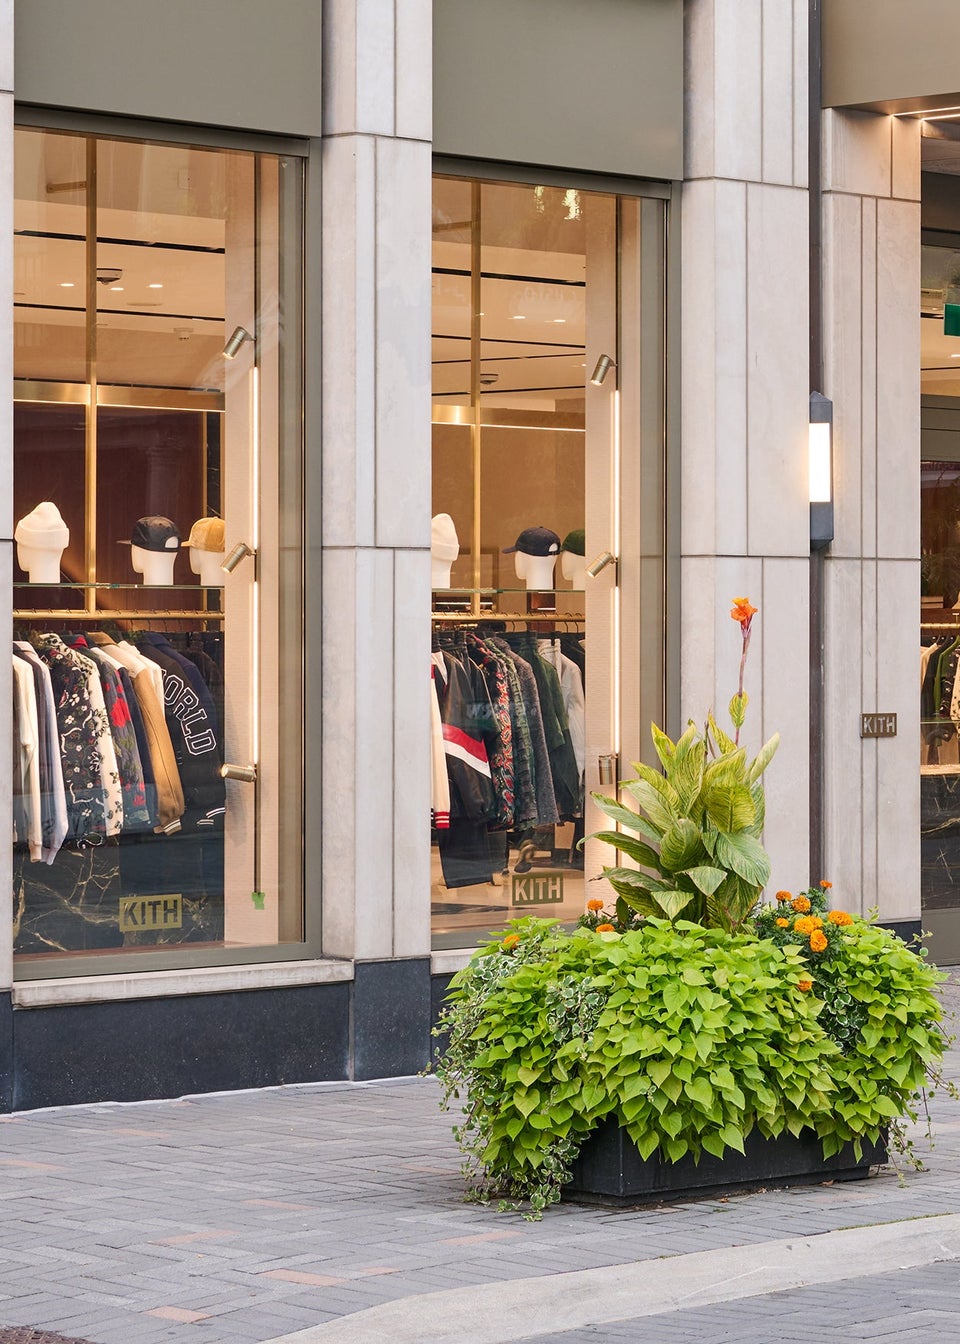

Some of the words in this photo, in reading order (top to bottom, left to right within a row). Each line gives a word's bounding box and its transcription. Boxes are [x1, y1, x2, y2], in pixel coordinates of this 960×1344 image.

[161, 668, 217, 756] ORLD
[863, 716, 895, 734] KITH
[515, 876, 561, 902] KITH
[123, 899, 178, 926] KITH
